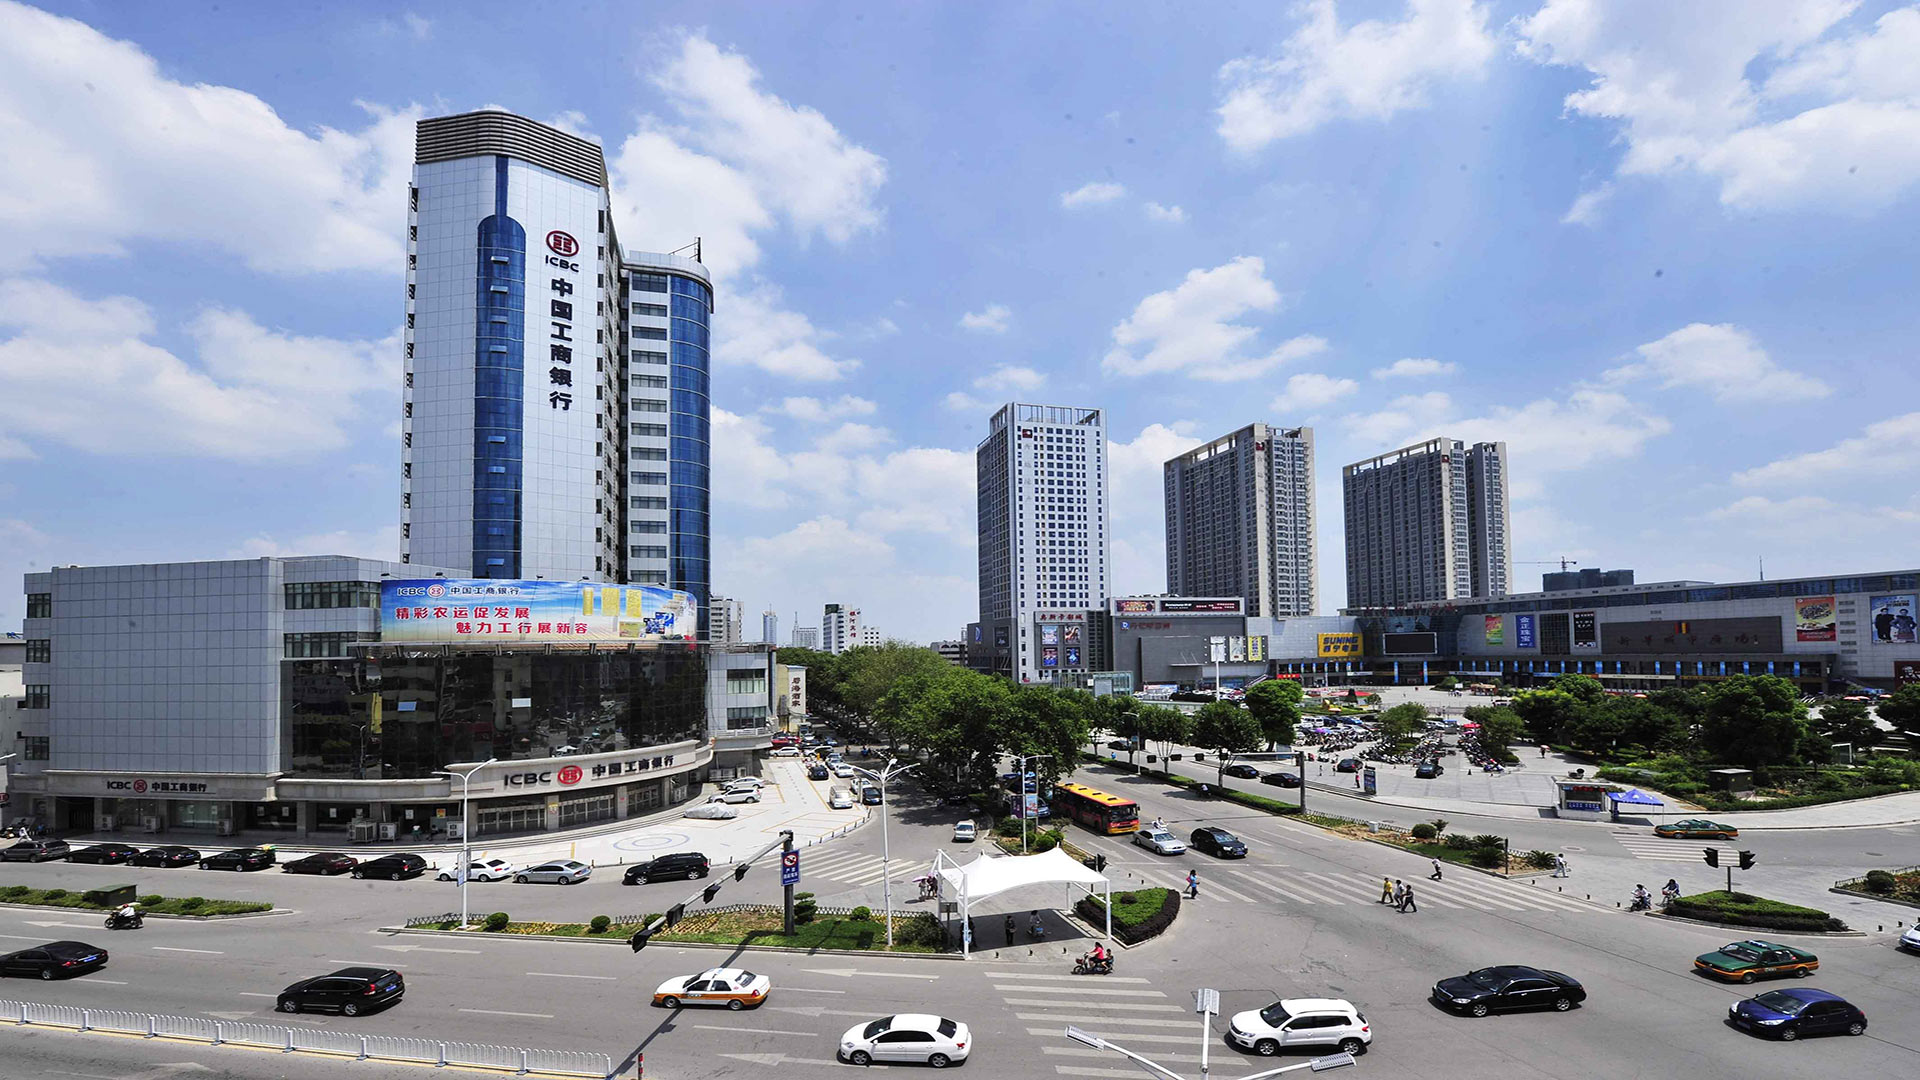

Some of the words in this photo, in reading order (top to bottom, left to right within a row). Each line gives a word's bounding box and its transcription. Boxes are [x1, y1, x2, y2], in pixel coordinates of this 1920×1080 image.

[545, 255, 579, 272] ICBC
[549, 277, 573, 411] 中国工商银行
[397, 587, 425, 596] ICBC
[450, 586, 519, 595] 中国工商银行
[395, 606, 529, 619] 精彩农运促发展
[456, 622, 588, 634] 魅力工行展新容
[1323, 636, 1359, 645] SUNING
[504, 772, 551, 787] ICBC
[591, 755, 674, 777] 中国工商银行
[107, 781, 132, 790] ICBC
[151, 782, 207, 792] 中国工商银行
